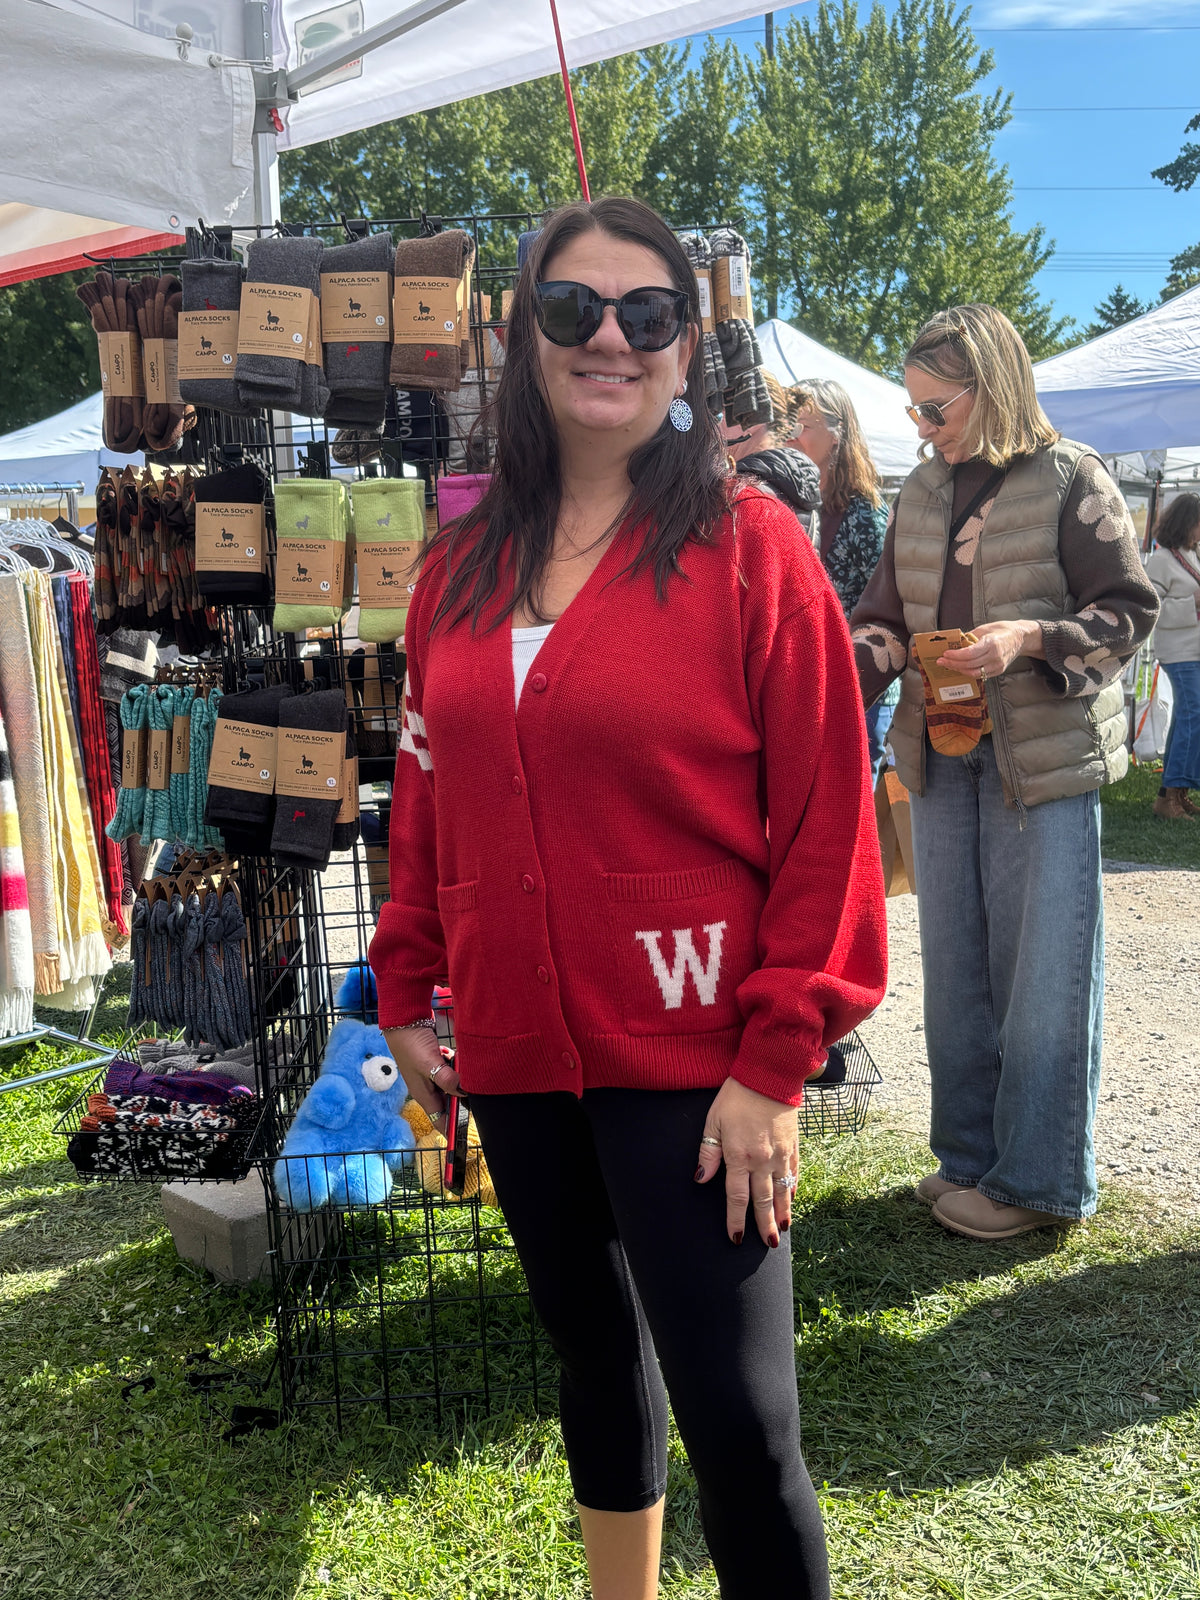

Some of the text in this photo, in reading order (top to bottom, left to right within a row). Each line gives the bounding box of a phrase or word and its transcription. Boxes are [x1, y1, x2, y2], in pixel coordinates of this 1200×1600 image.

[396, 390, 412, 438] AMPO
[224, 725, 250, 733] ALPACA
[635, 920, 727, 1010] W
